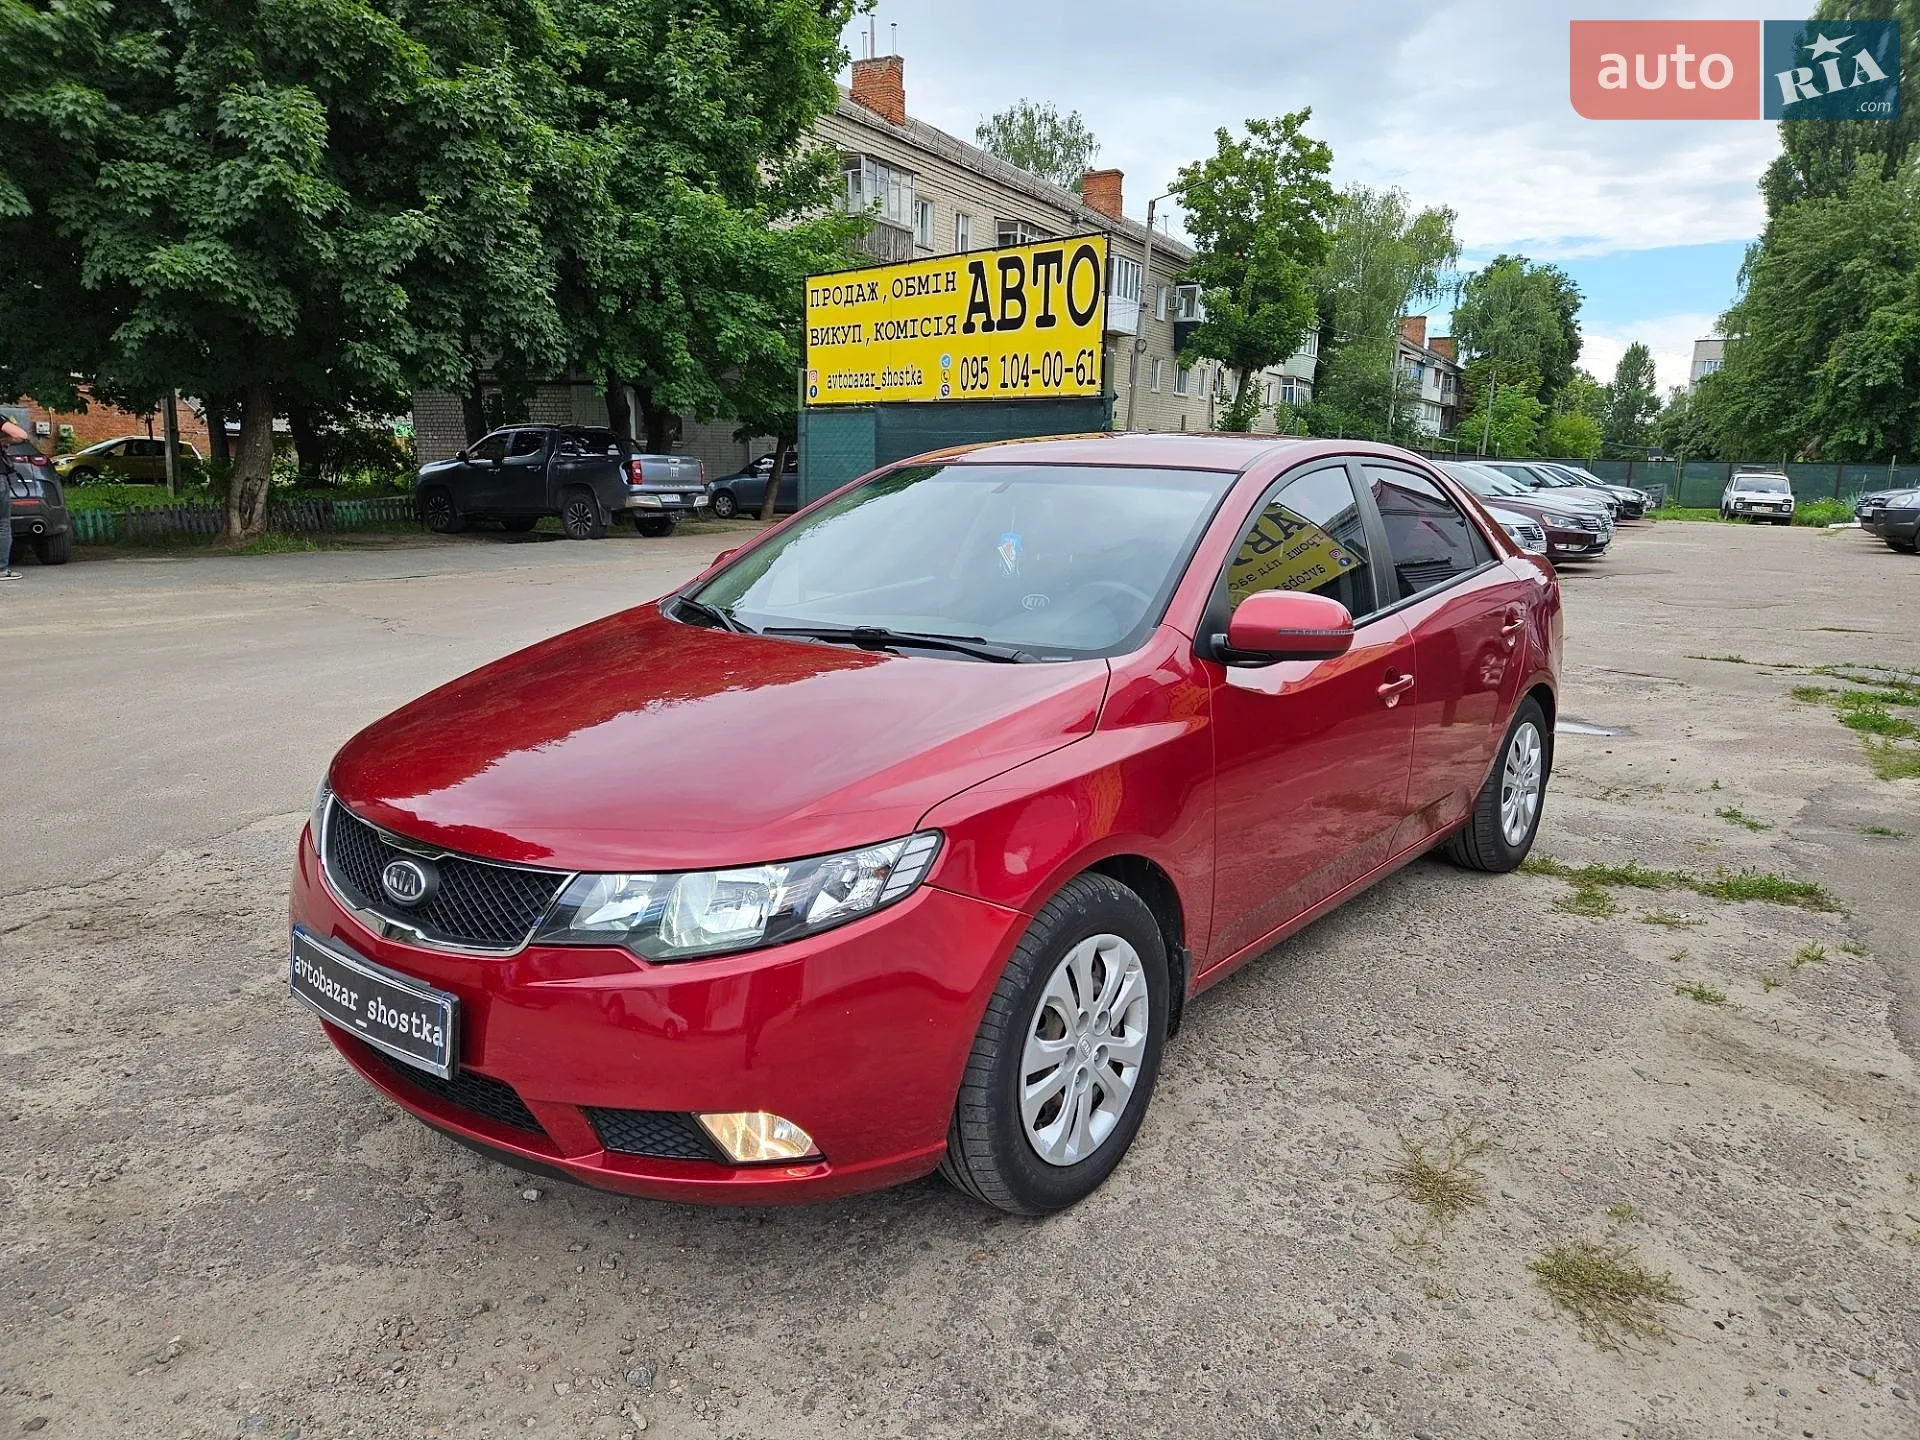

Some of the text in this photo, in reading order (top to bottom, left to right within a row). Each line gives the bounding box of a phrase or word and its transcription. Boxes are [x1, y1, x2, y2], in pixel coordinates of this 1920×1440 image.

[892, 271, 957, 299] ОБМІН
[961, 244, 1101, 335] АВТО
[873, 315, 957, 342] КОМІСІЯ
[827, 366, 923, 391] avtobazar_shostka
[960, 350, 1097, 391] 095 104-00-61
[388, 867, 416, 895] KIA
[294, 954, 444, 1048] avtobazar_shostka
